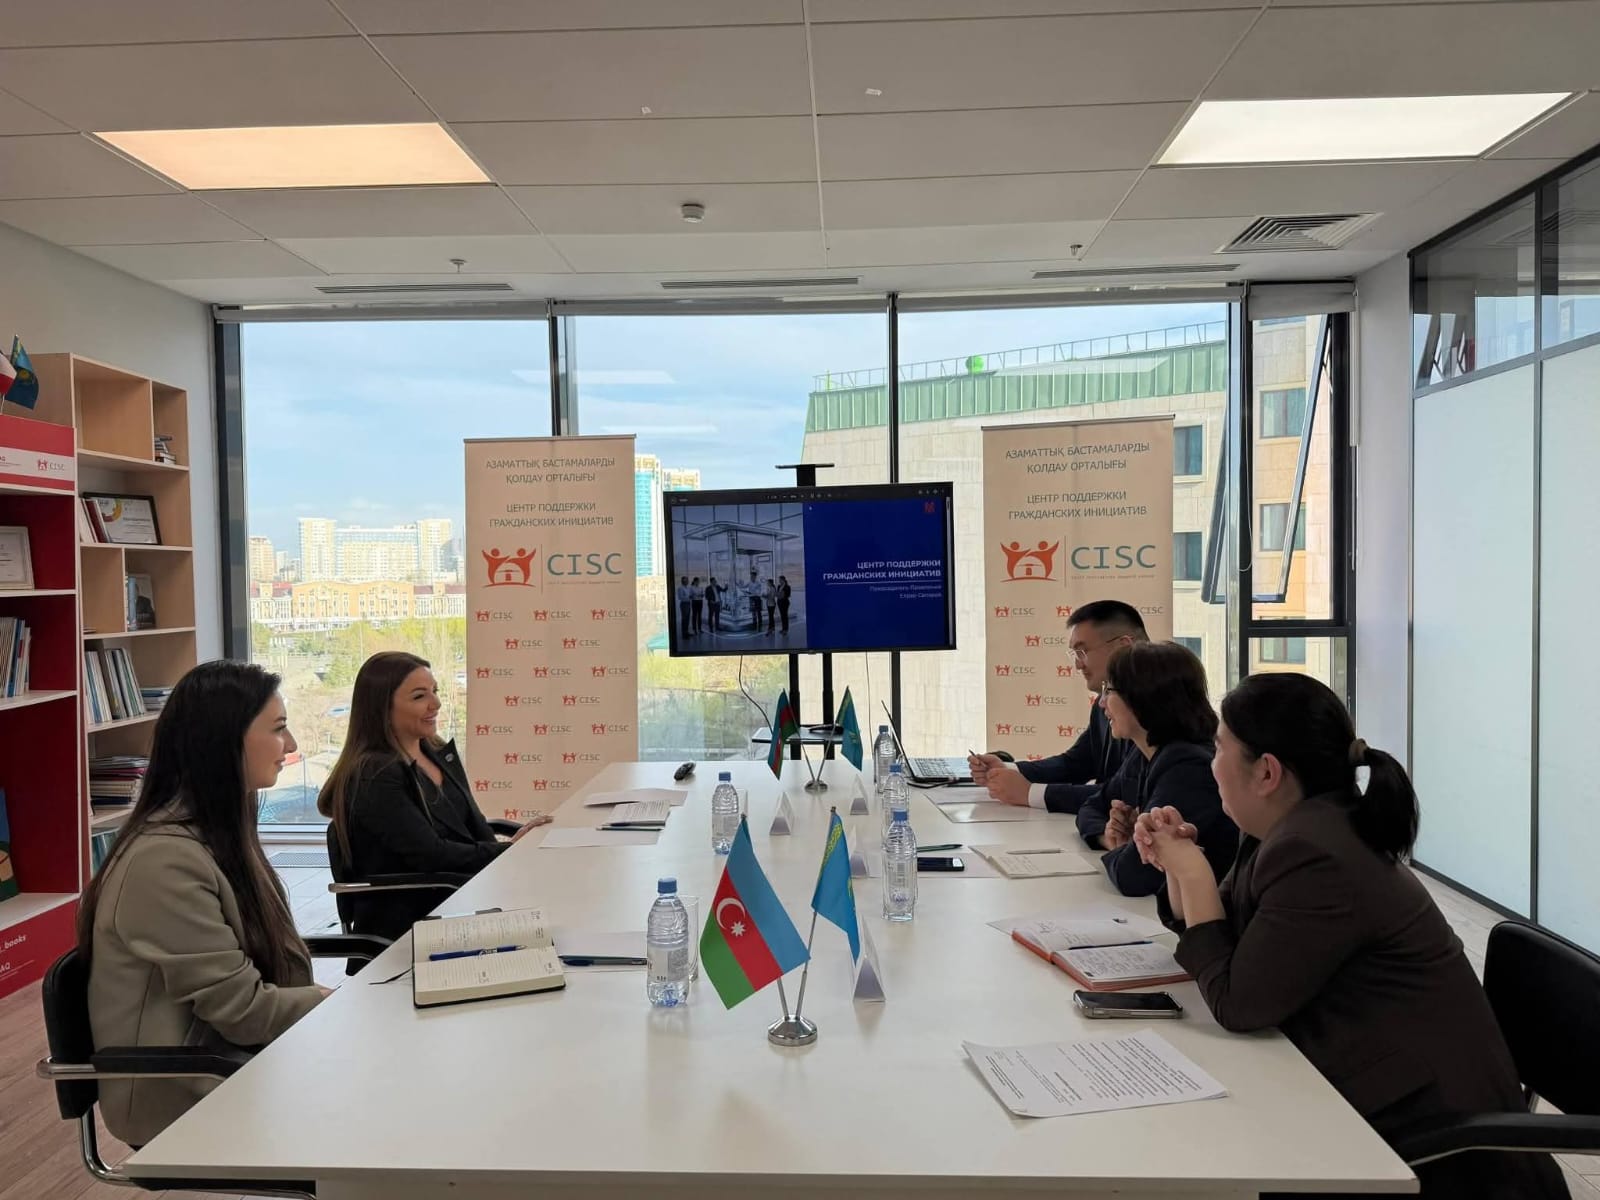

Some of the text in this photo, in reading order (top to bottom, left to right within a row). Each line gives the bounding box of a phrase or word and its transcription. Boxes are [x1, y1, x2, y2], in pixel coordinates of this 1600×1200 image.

[1005, 442, 1150, 459] АЗАМАТТЫҚ БАСТАМАЛАРДЫ
[486, 457, 615, 469] АЗАМАТТЫҚ БАСТАМАЛАРДЫ
[1027, 459, 1127, 474] ҚОЛДАУ ОРТАЛЫҒЫ
[506, 473, 596, 484] ҚОЛДАУ ОРТАЛЫҒЫ
[1027, 491, 1127, 504] ЦЕНТР ПОДДЕРЖКИ
[506, 503, 596, 513] ЦЕНТР ПОДДЕРЖКИ
[1008, 506, 1148, 520] ГРАЖДАНСКИХ ИНИЦИАТИВ
[489, 517, 614, 528] ГРАЖДАНСКИХ ИНИЦИАТИВ
[1071, 545, 1157, 570] CISC
[547, 553, 622, 576] CISC
[857, 560, 942, 569] ЦЕНТР ПОДДЕРЖКИ
[823, 570, 942, 580] ГРАЖДАНСКИХ ИНИЦИАТИВ
[608, 610, 629, 618] CISC
[1012, 607, 1036, 616] CISC
[1140, 606, 1164, 614] CISC
[551, 611, 572, 619] CISC
[521, 639, 543, 647] CISC
[579, 639, 600, 647] CISC
[1043, 635, 1066, 645] CISC
[492, 668, 514, 676] CISC
[551, 668, 572, 676] CISC
[608, 667, 629, 675] CISC
[1013, 666, 1036, 674] CISC
[579, 696, 600, 704] CISC
[1044, 696, 1067, 705] CISC
[492, 726, 513, 734] CISC
[551, 725, 572, 733] CISC
[608, 724, 629, 732] CISC
[1014, 725, 1037, 734] CISC
[521, 754, 543, 762] CISC
[492, 781, 512, 789] CISC
[550, 780, 572, 788] CISC
